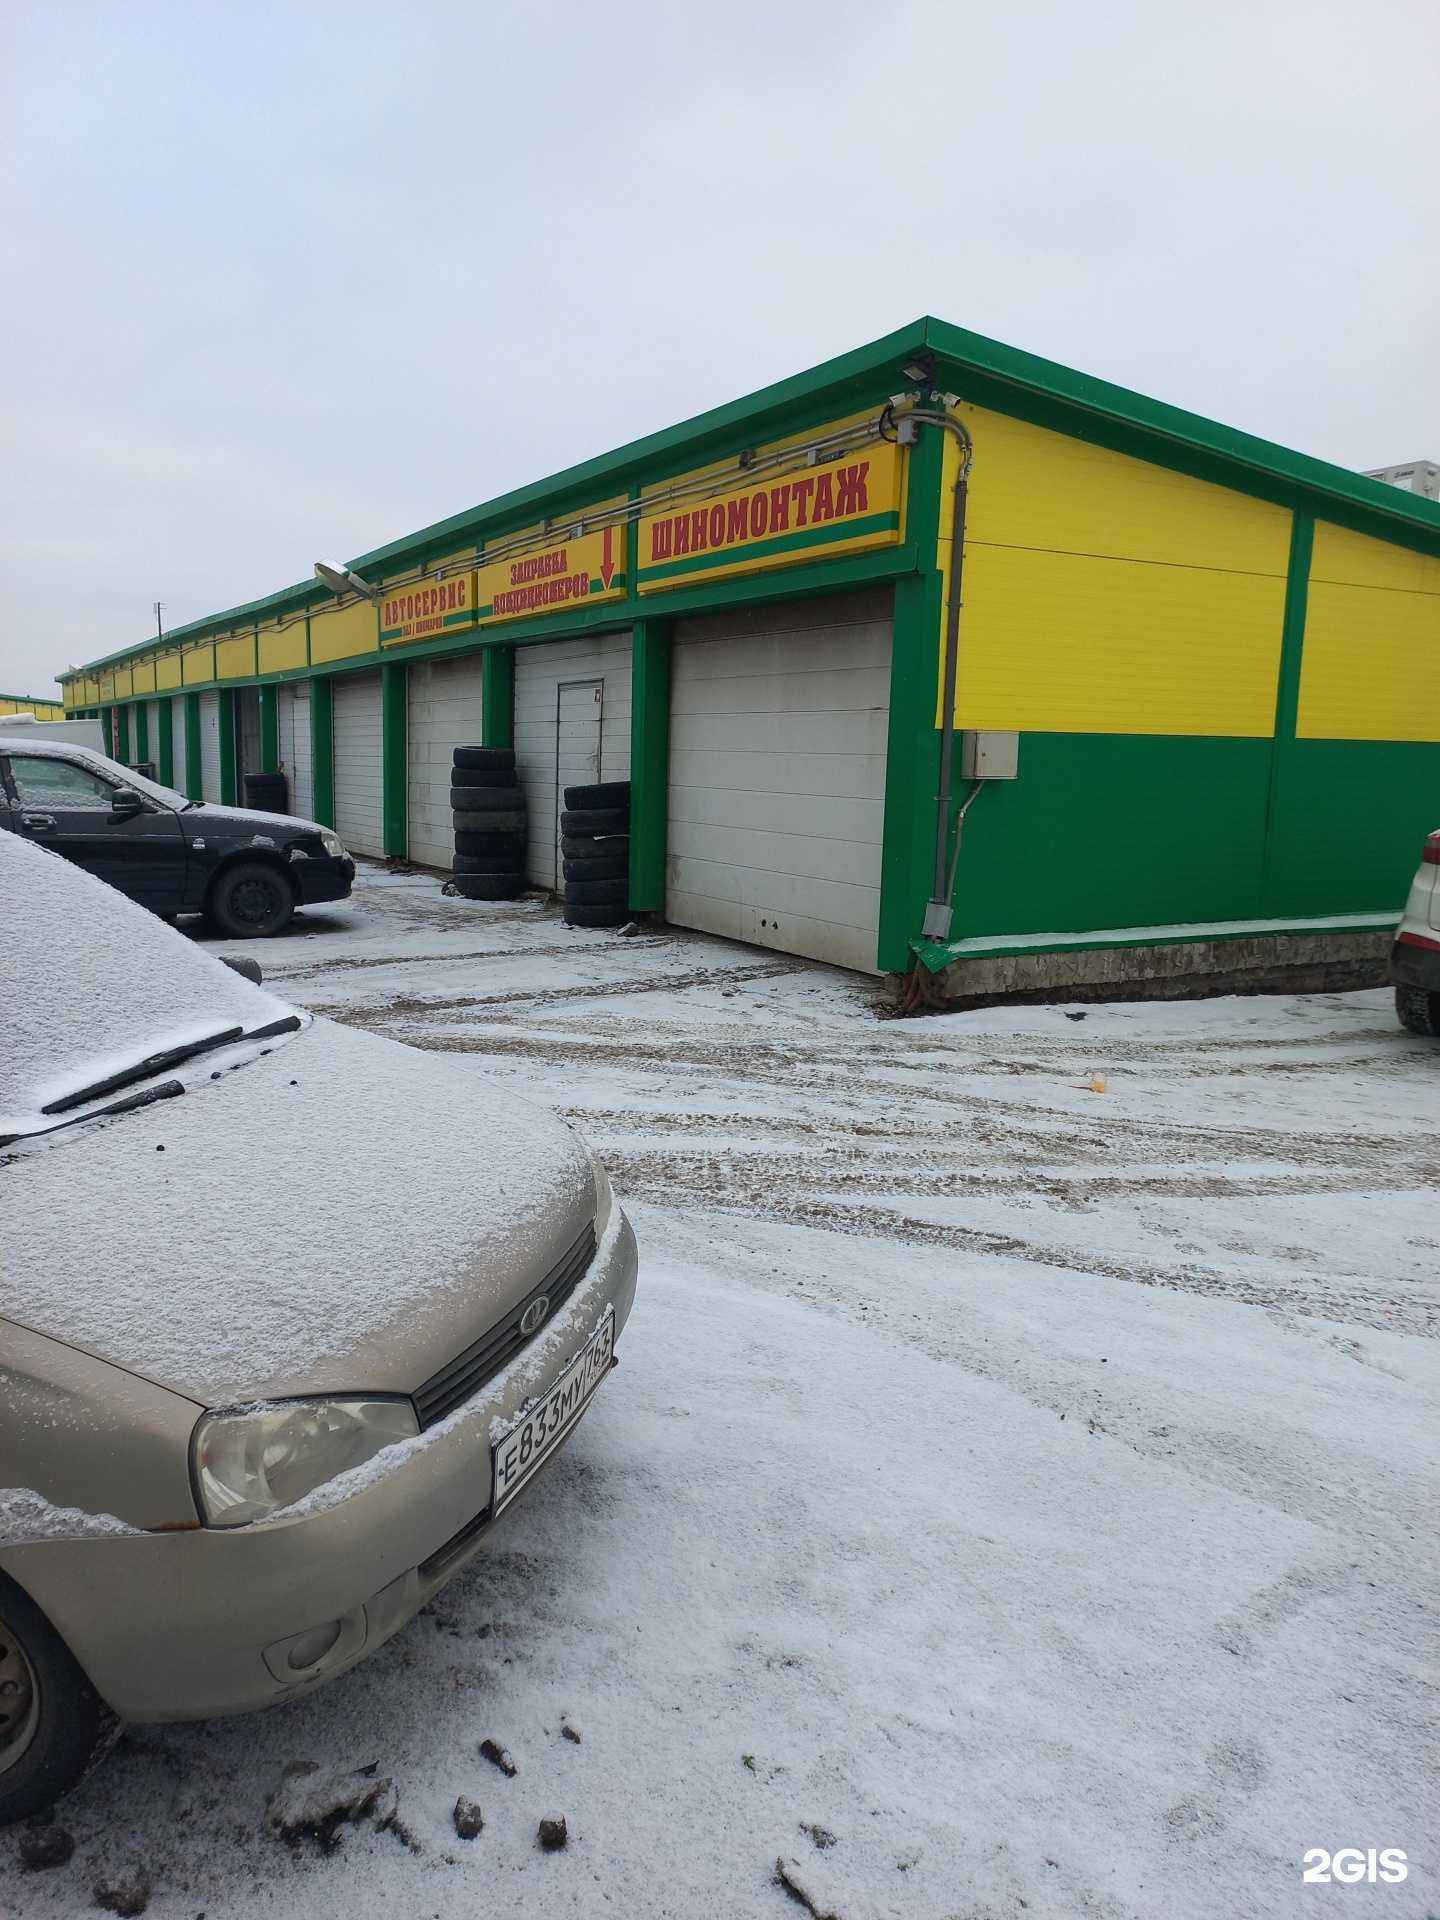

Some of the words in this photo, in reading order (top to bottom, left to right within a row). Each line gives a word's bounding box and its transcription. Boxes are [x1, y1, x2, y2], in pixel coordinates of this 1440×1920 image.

[651, 461, 871, 562] ШИНОМОНТАЖ
[510, 549, 567, 585] ЗАПРАВКА
[385, 580, 465, 626] АВТОСЕРВИС
